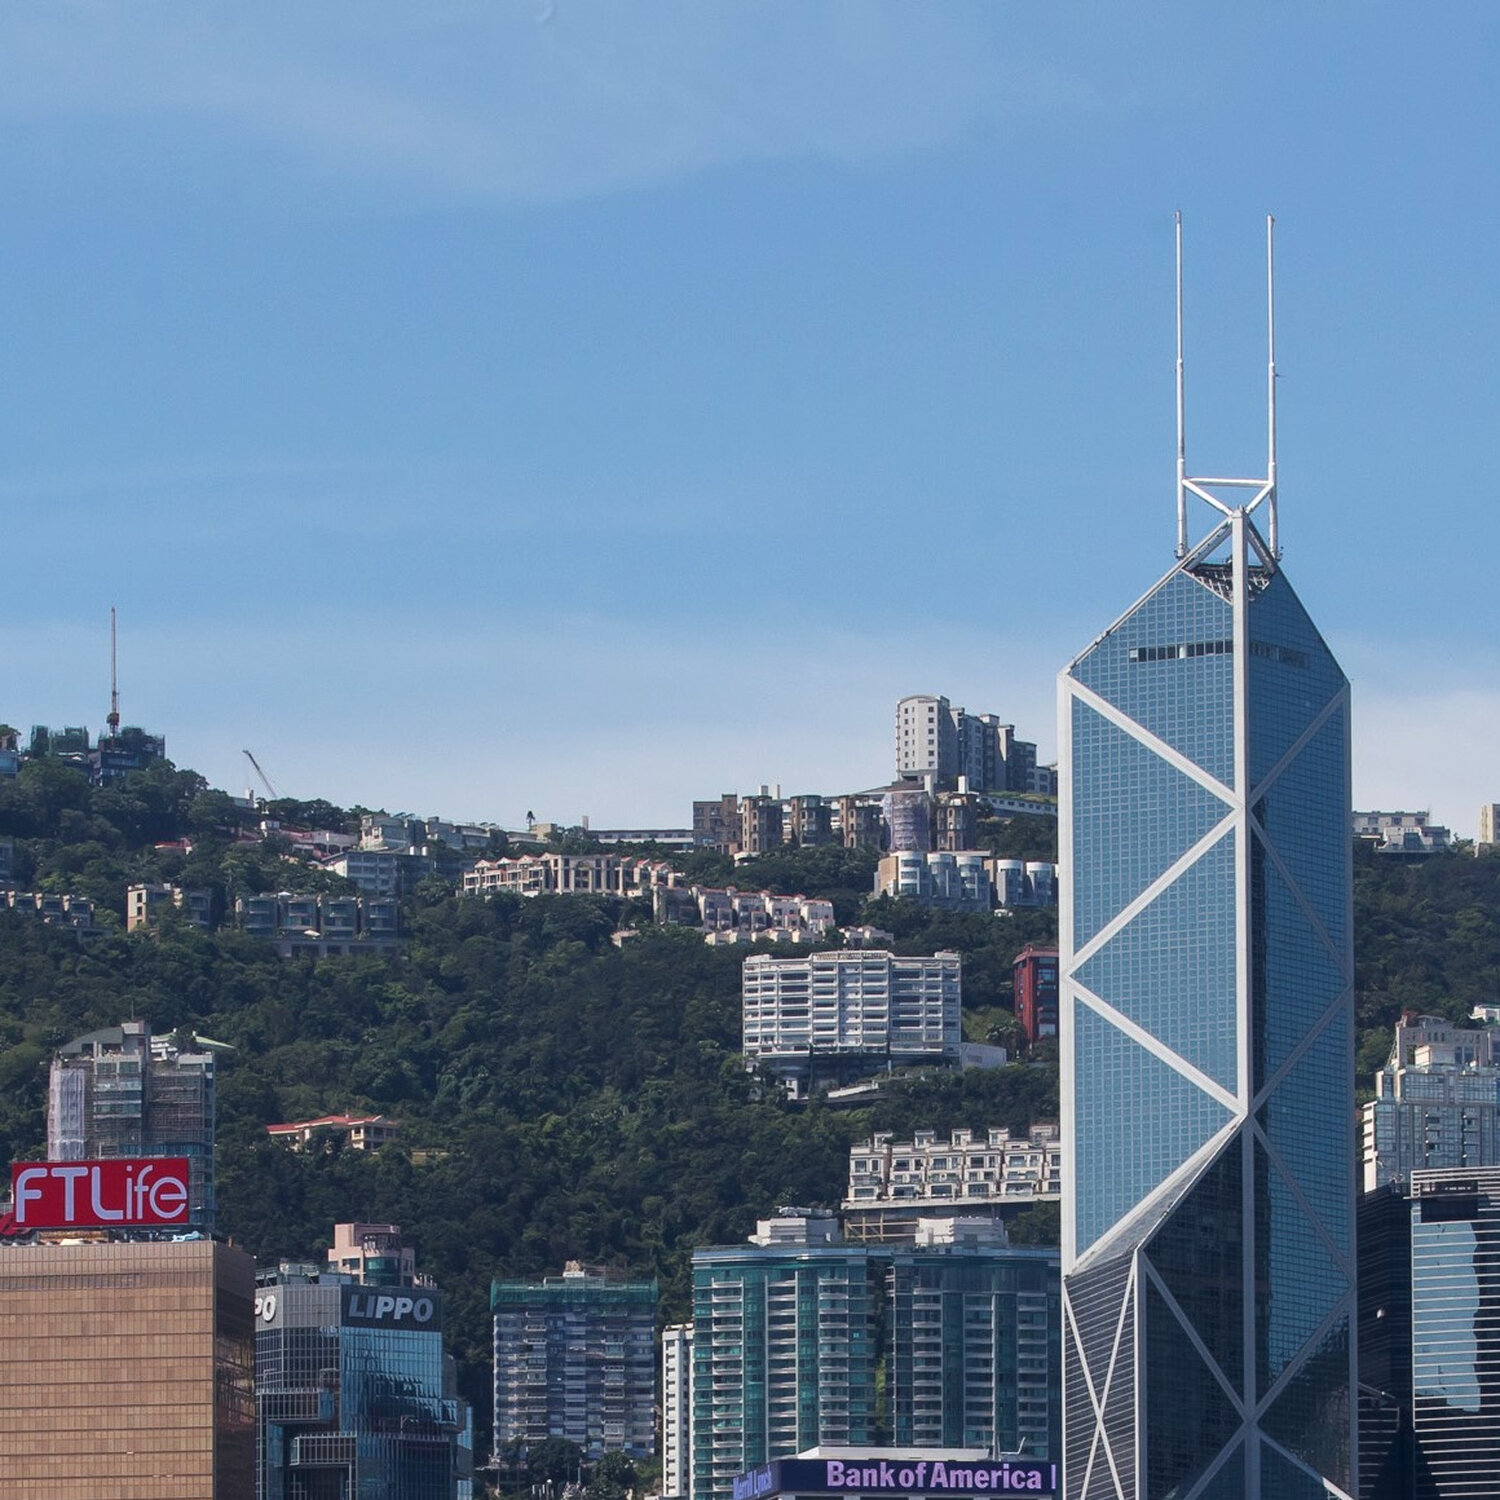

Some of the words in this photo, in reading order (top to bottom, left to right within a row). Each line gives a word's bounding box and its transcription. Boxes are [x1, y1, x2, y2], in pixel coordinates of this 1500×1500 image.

[16, 1165, 187, 1222] FTLife
[351, 1295, 433, 1322] LIPPO
[827, 1461, 895, 1487] Bank
[900, 1462, 926, 1488] of
[930, 1462, 1042, 1489] America
